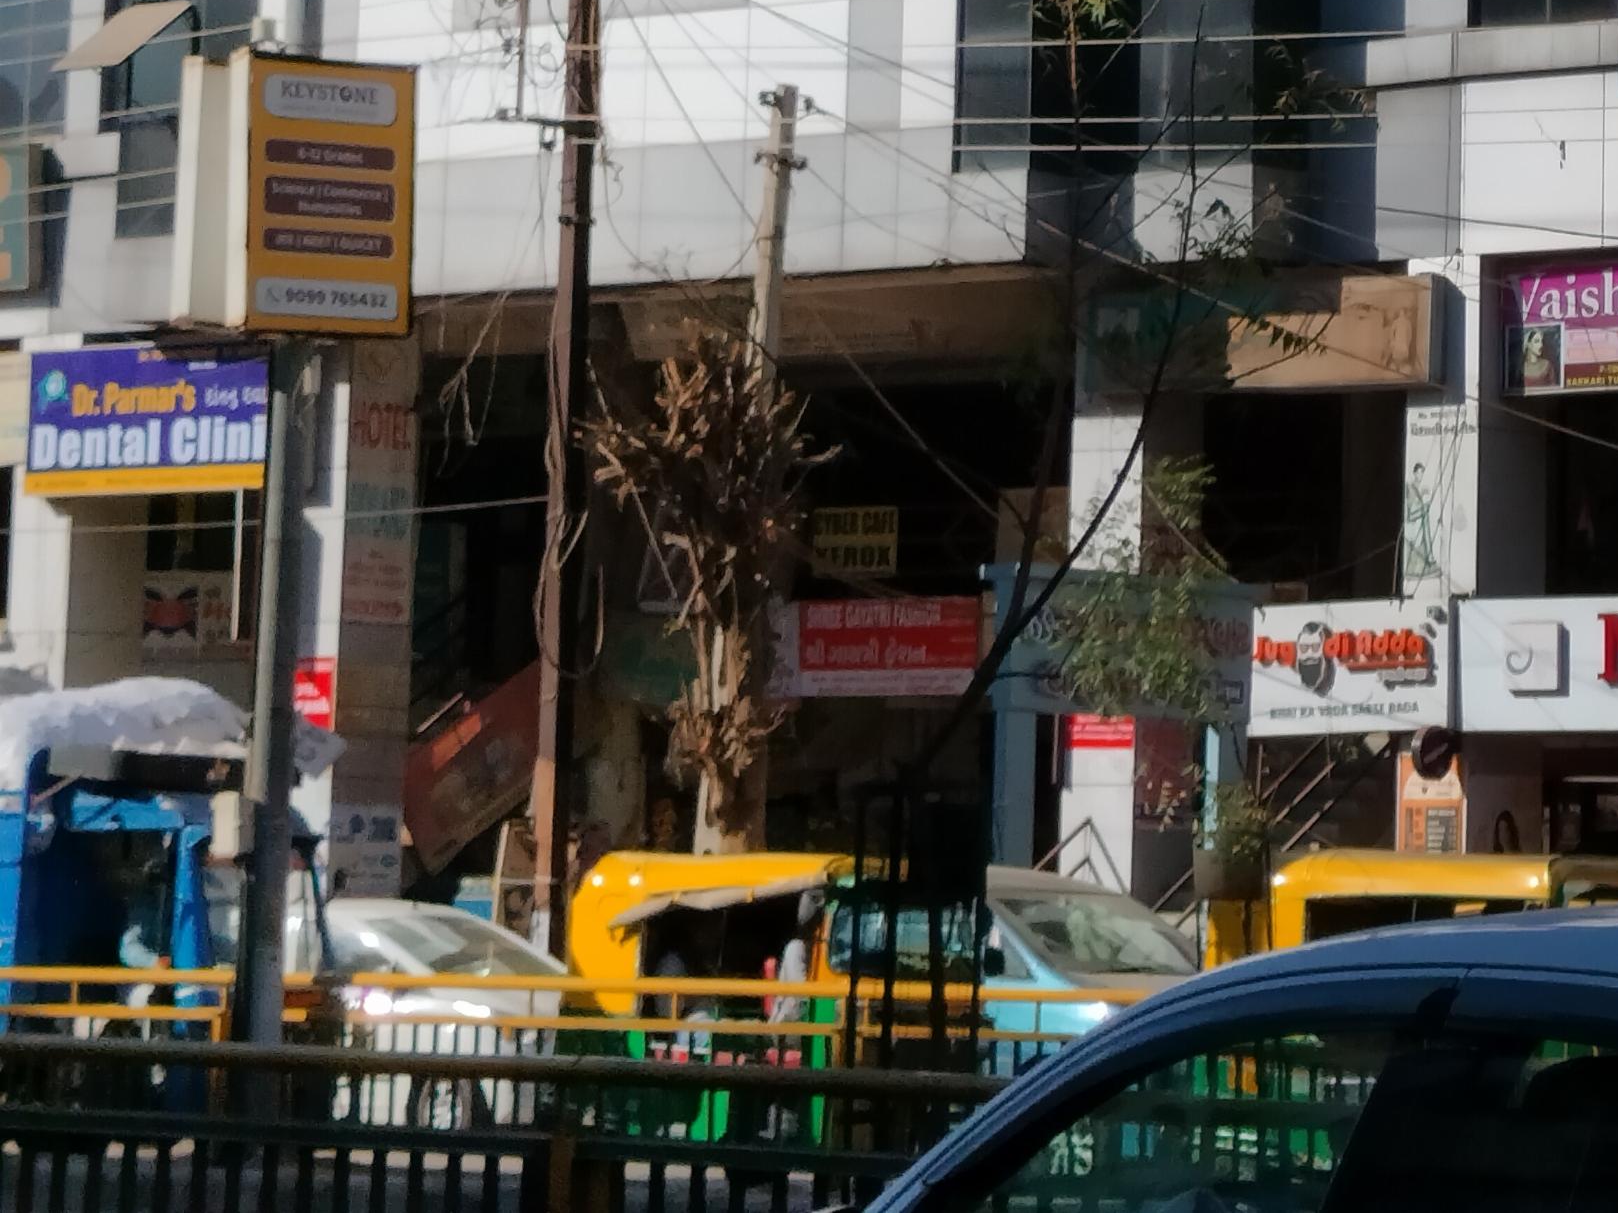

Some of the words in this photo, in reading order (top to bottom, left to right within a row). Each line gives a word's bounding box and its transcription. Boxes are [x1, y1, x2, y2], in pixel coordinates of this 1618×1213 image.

[280, 80, 379, 105] KEYSTONE
[285, 288, 325, 304] 9099
[71, 382, 101, 417] Dr.
[103, 378, 197, 416] Parmar's
[31, 418, 162, 470] Dental
[169, 414, 268, 465] Clini
[862, 510, 896, 534] CAFE
